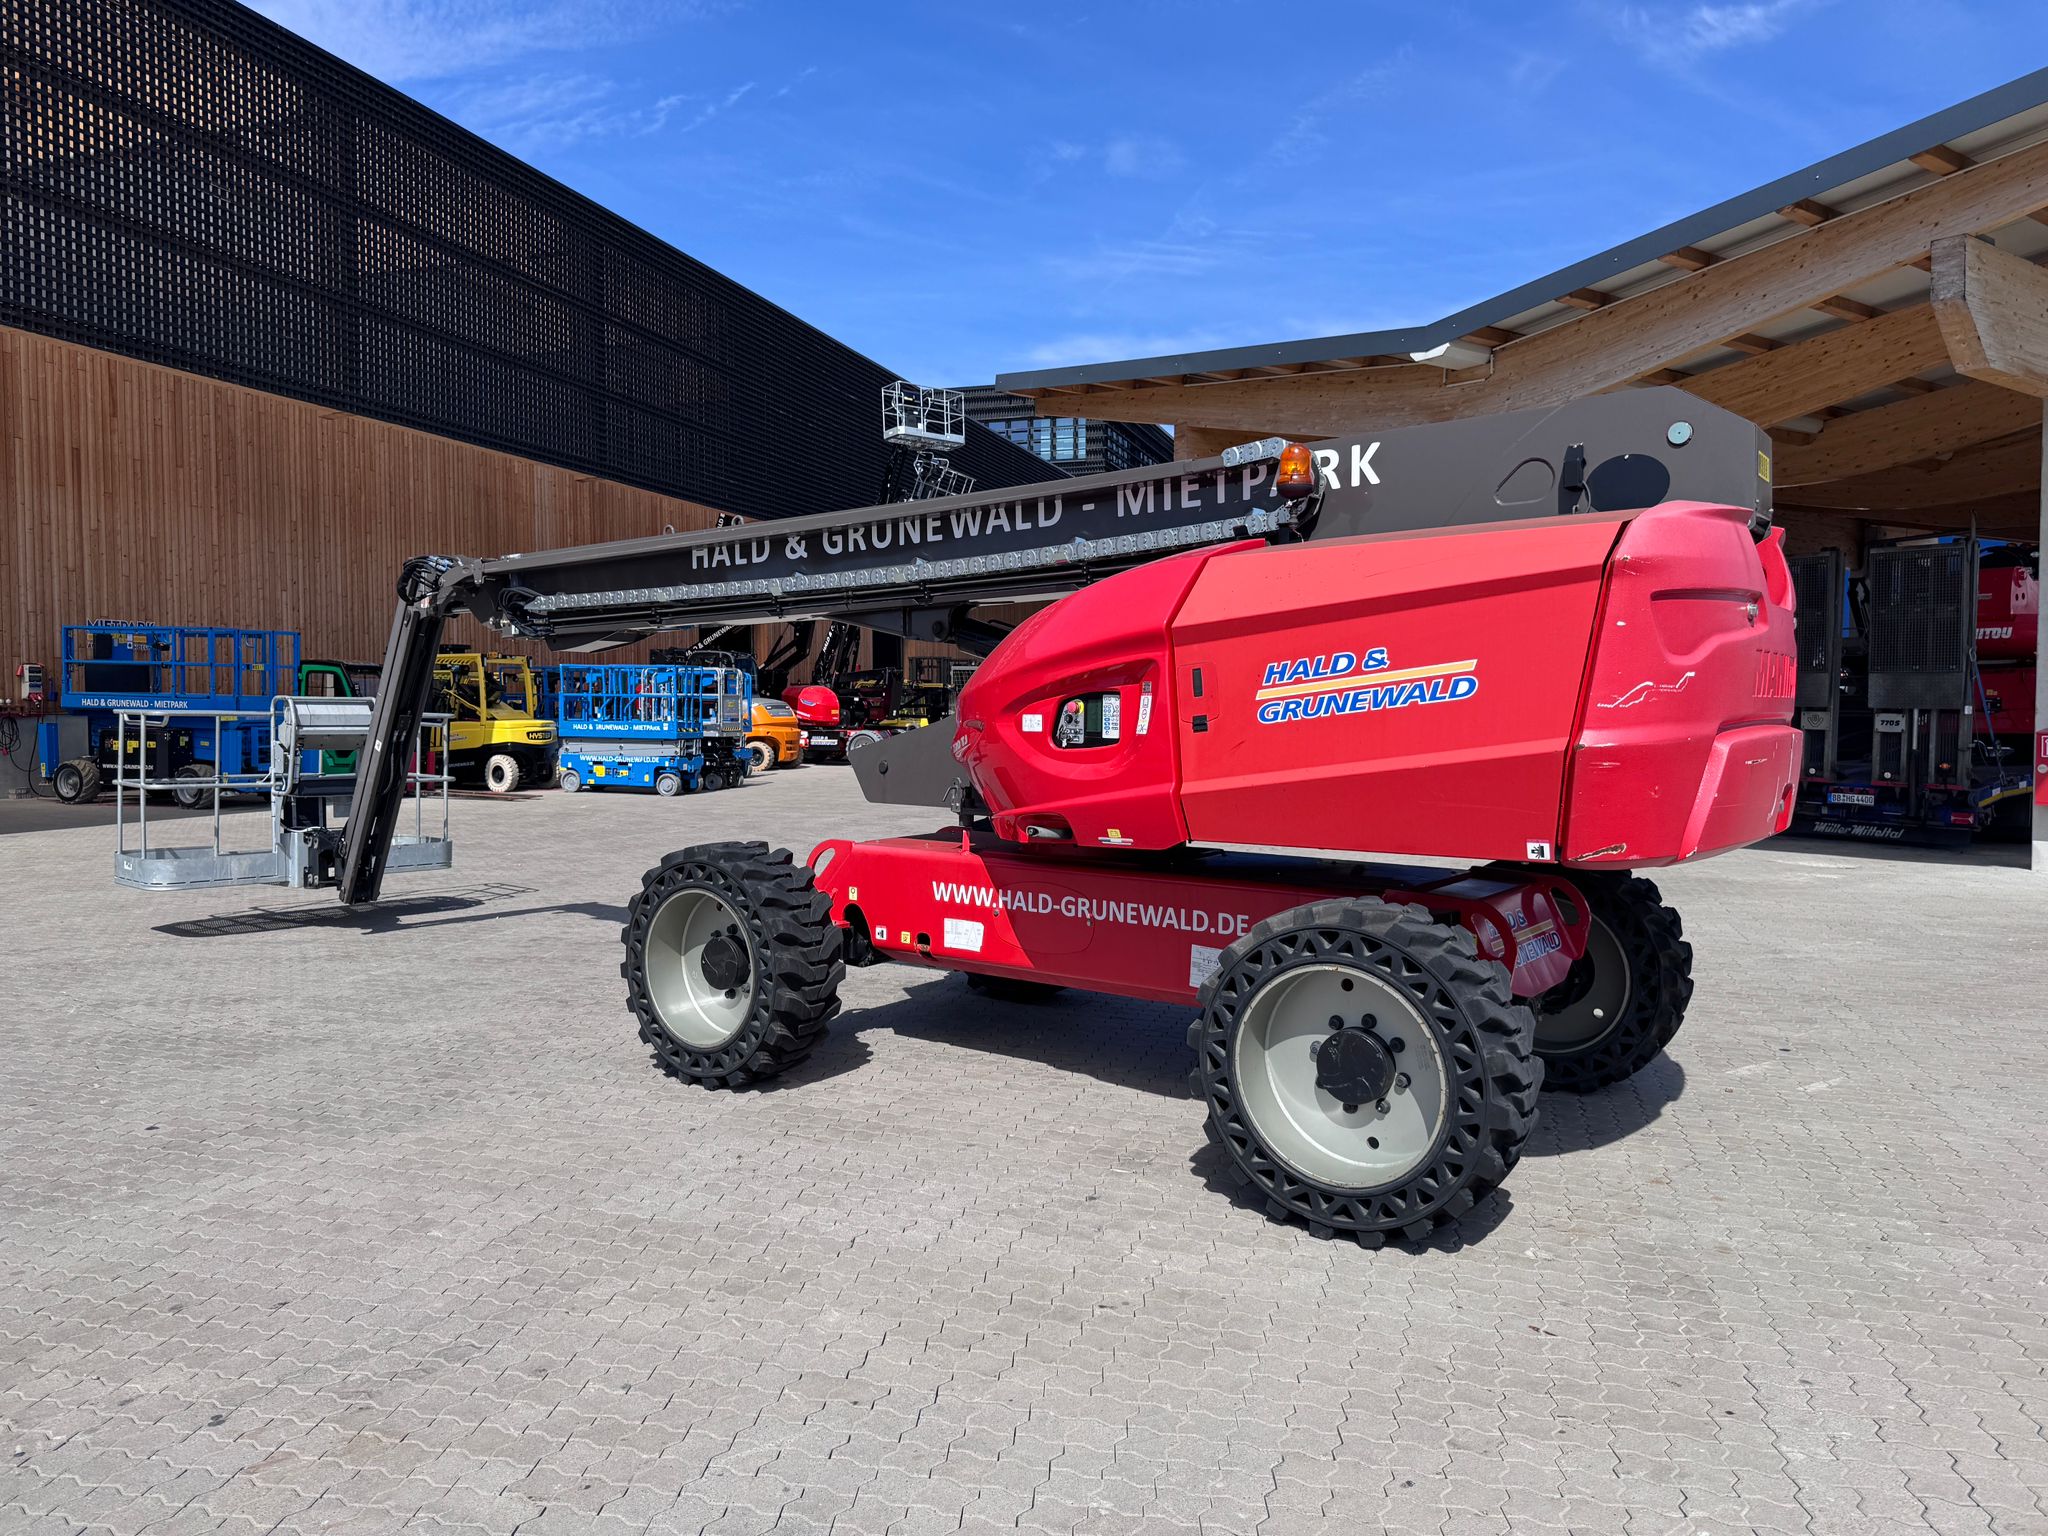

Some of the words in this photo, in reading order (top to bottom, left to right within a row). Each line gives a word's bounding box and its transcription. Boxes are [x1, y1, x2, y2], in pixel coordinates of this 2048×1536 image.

[691, 536, 770, 569] HALD
[785, 532, 807, 560] &
[822, 494, 1064, 555] GRUNEWALD
[1264, 654, 1355, 684] HALD
[1363, 648, 1388, 669] &
[82, 698, 99, 706] HALD
[101, 698, 105, 706] &
[107, 699, 149, 708] GRUNEWALD
[154, 701, 188, 709] MIETPARK
[1258, 677, 1477, 723] GRUNEWALD
[1813, 821, 1851, 834] Müller
[1851, 824, 1904, 839] Mitteltal
[932, 881, 1250, 937] WWW.HALD-GRUNEWALD.DE
